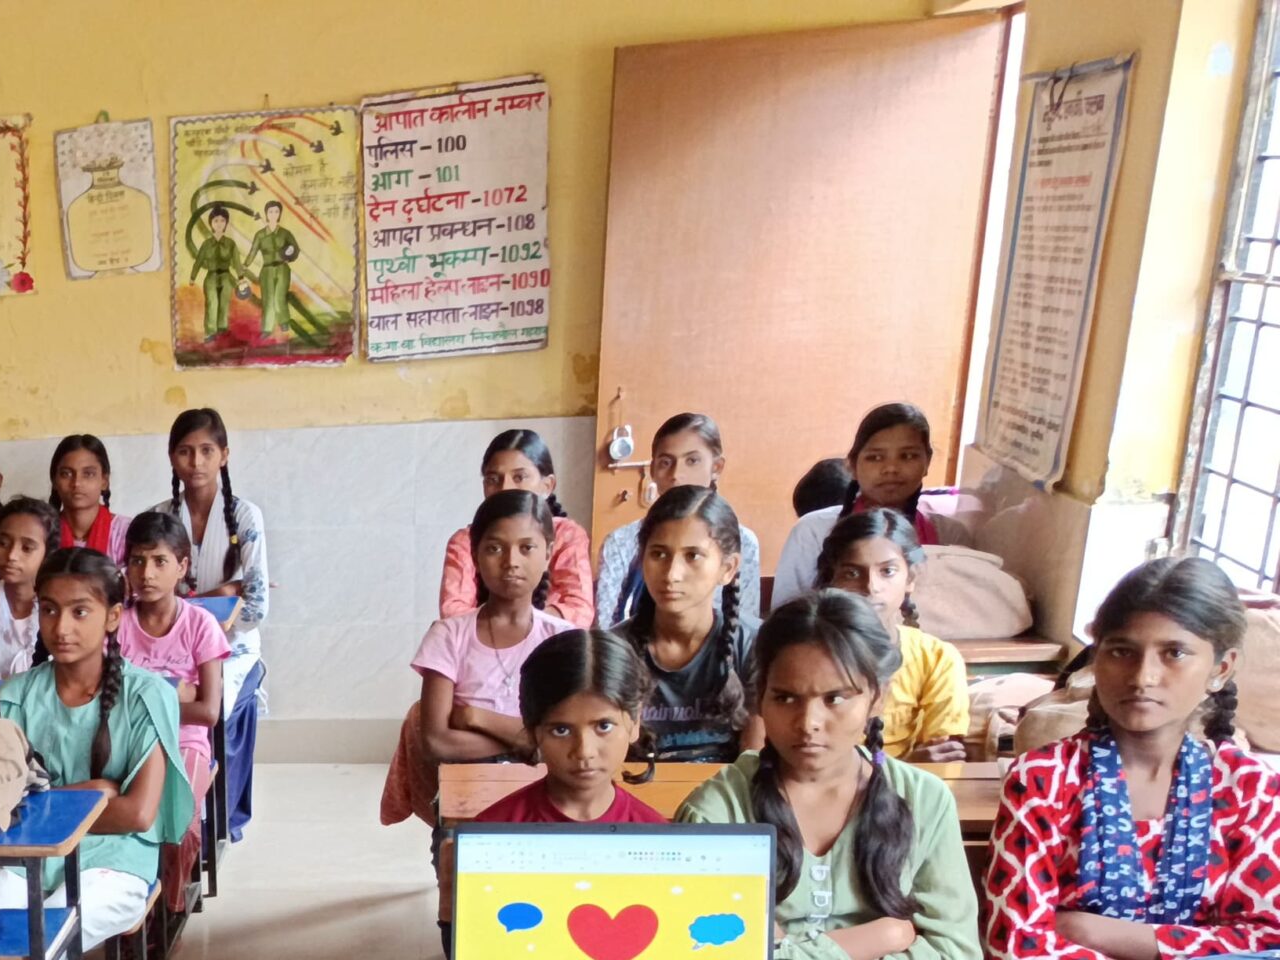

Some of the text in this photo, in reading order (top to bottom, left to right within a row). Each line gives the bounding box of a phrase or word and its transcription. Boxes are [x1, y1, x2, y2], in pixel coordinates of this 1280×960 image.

[365, 136, 418, 168] पुलिस
[436, 135, 467, 153] 100
[371, 169, 413, 192] आग
[435, 165, 460, 183] 101
